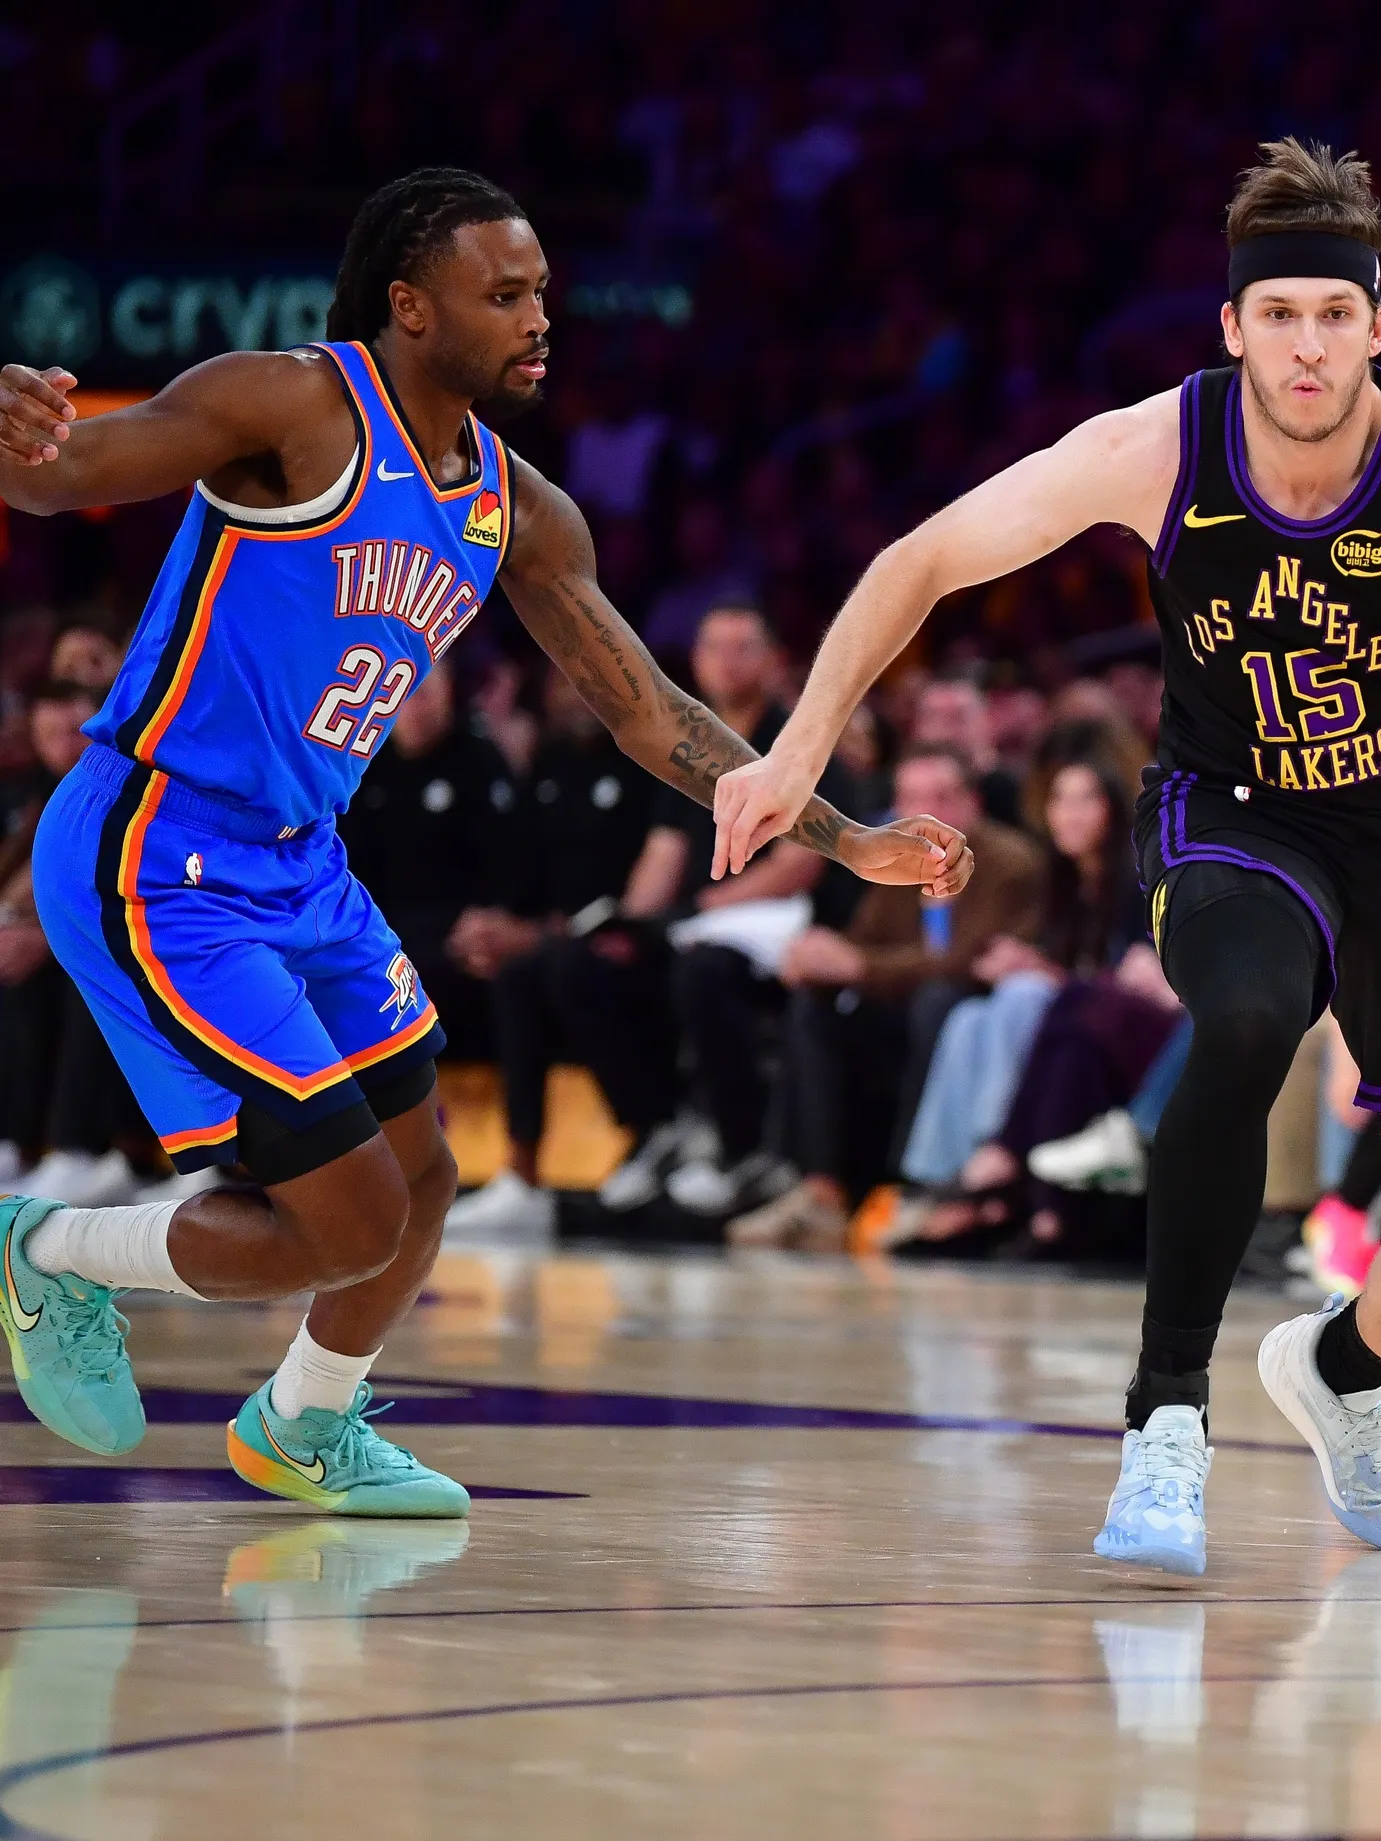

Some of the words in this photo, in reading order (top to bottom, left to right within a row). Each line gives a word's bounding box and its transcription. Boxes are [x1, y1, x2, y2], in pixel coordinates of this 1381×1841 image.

[465, 521, 498, 543] Loves
[1182, 598, 1235, 667] LOS
[302, 644, 416, 759] 22
[1240, 649, 1366, 742] 15
